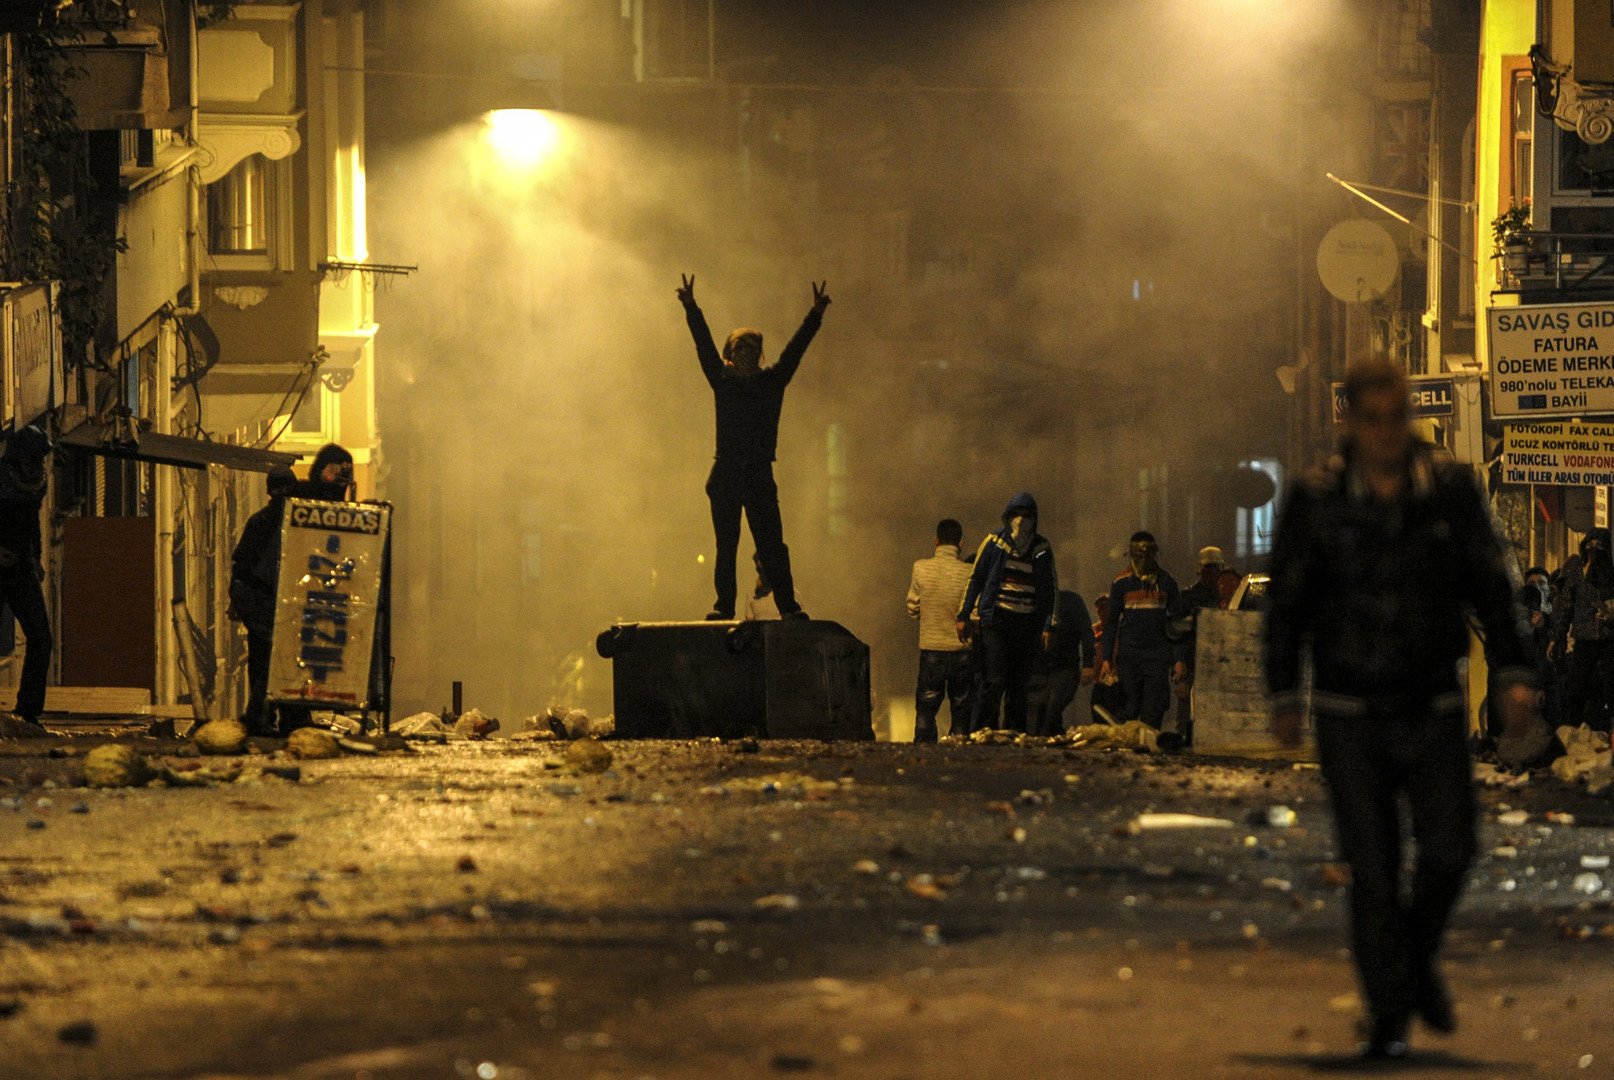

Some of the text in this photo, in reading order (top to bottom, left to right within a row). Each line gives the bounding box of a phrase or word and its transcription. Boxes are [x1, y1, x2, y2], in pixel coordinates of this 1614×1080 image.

[1498, 310, 1614, 334] SAVAŞ GID
[1534, 336, 1599, 353] FATURA
[1497, 355, 1614, 374] ÖDEME MERK
[1500, 379, 1557, 392] 980'nolu
[1511, 424, 1614, 436] FOTOKOPİ FAX CAL
[1510, 439, 1540, 449] UCUZ
[1542, 440, 1600, 451] KONTÖRLÜ
[1507, 453, 1559, 467] TURKCELL
[1506, 467, 1526, 482] TÜM
[1554, 472, 1580, 484] ARASI
